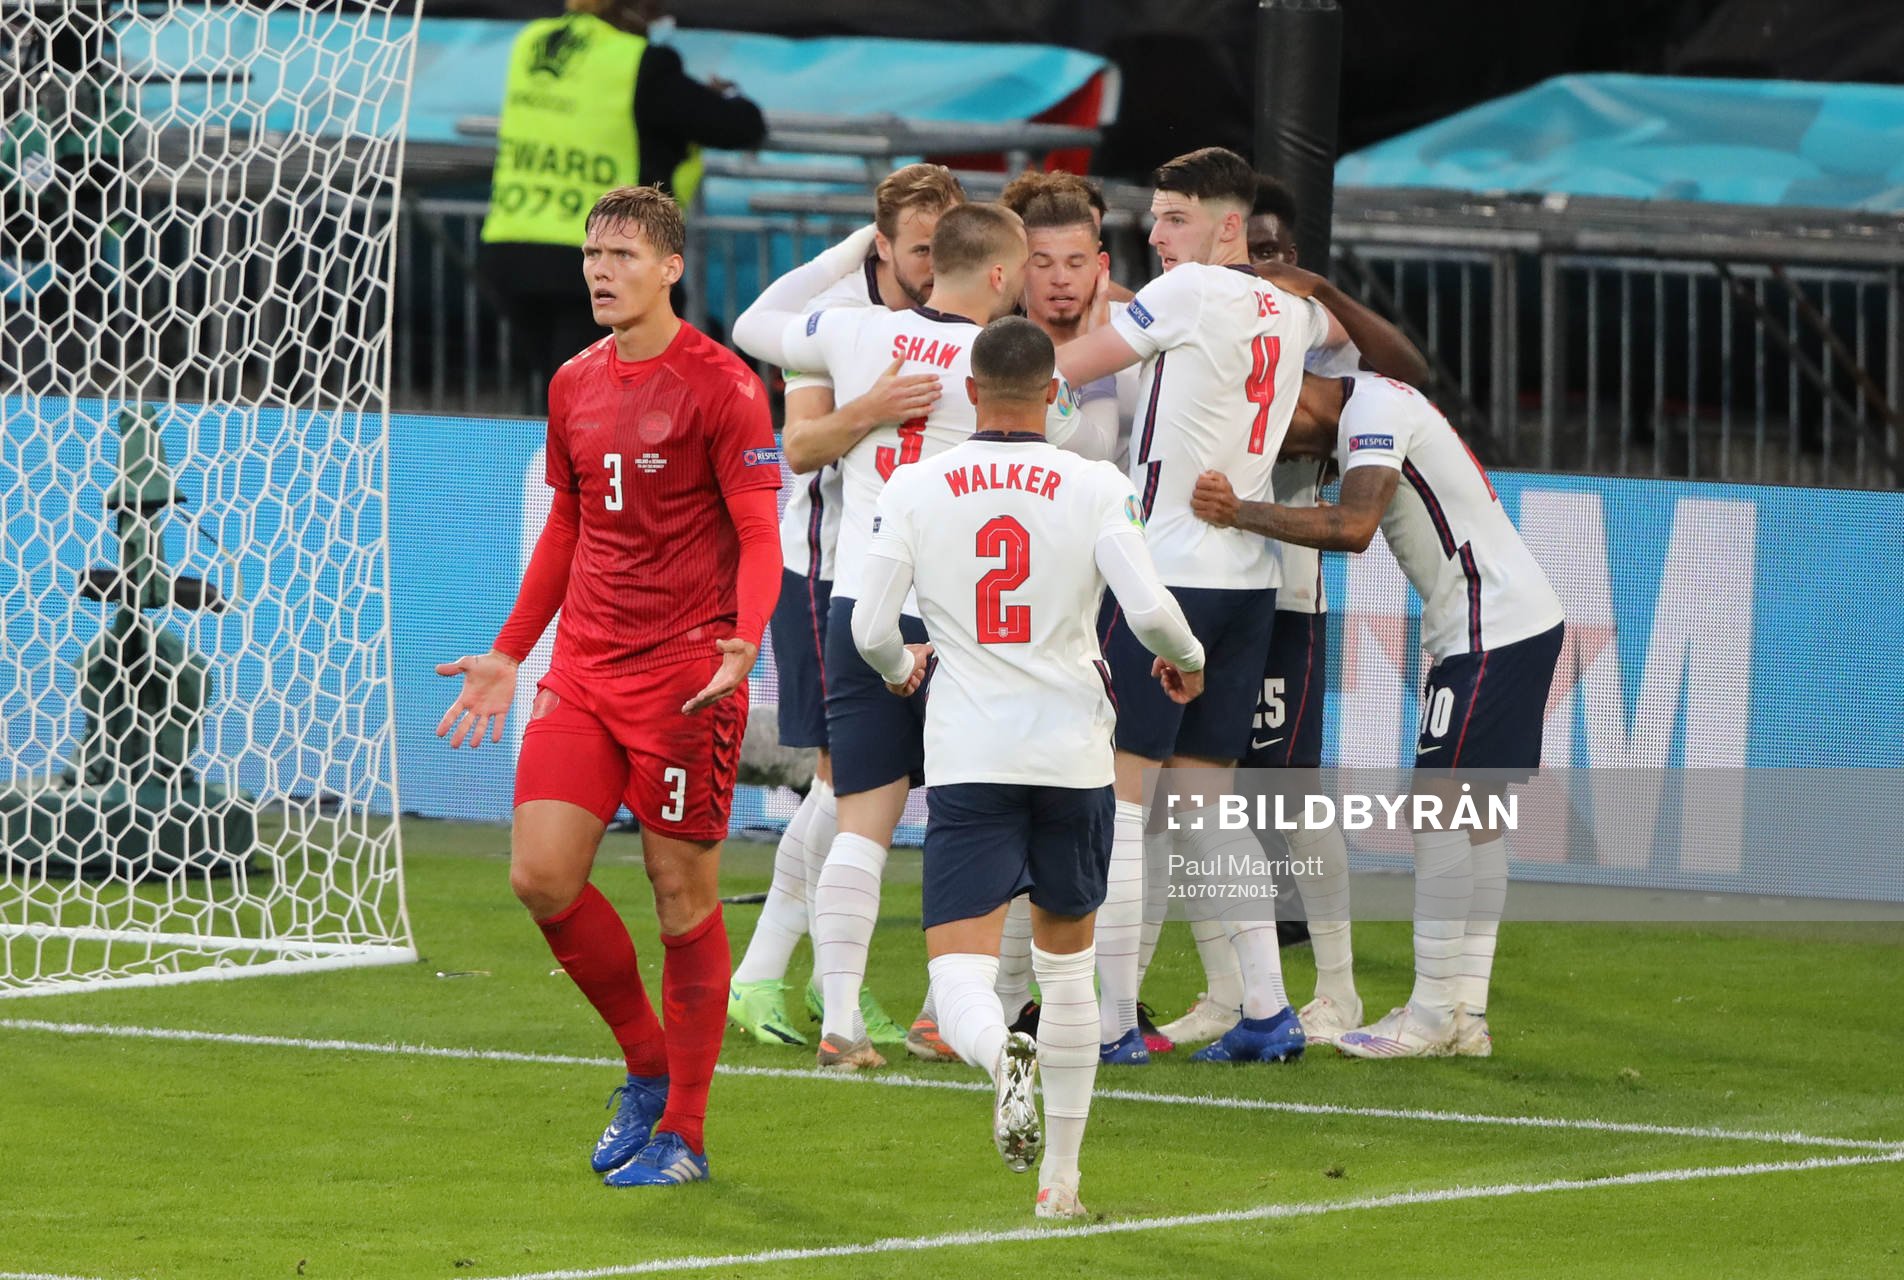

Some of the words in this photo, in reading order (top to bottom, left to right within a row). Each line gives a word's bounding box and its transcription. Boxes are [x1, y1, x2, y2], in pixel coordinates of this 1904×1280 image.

[892, 334, 962, 369] SHAW
[1245, 336, 1280, 454] 4
[1359, 437, 1393, 447] RESPECT
[603, 453, 623, 511] 3
[945, 463, 1062, 500] WALKER
[976, 515, 1031, 644] 2
[661, 767, 686, 822] 3
